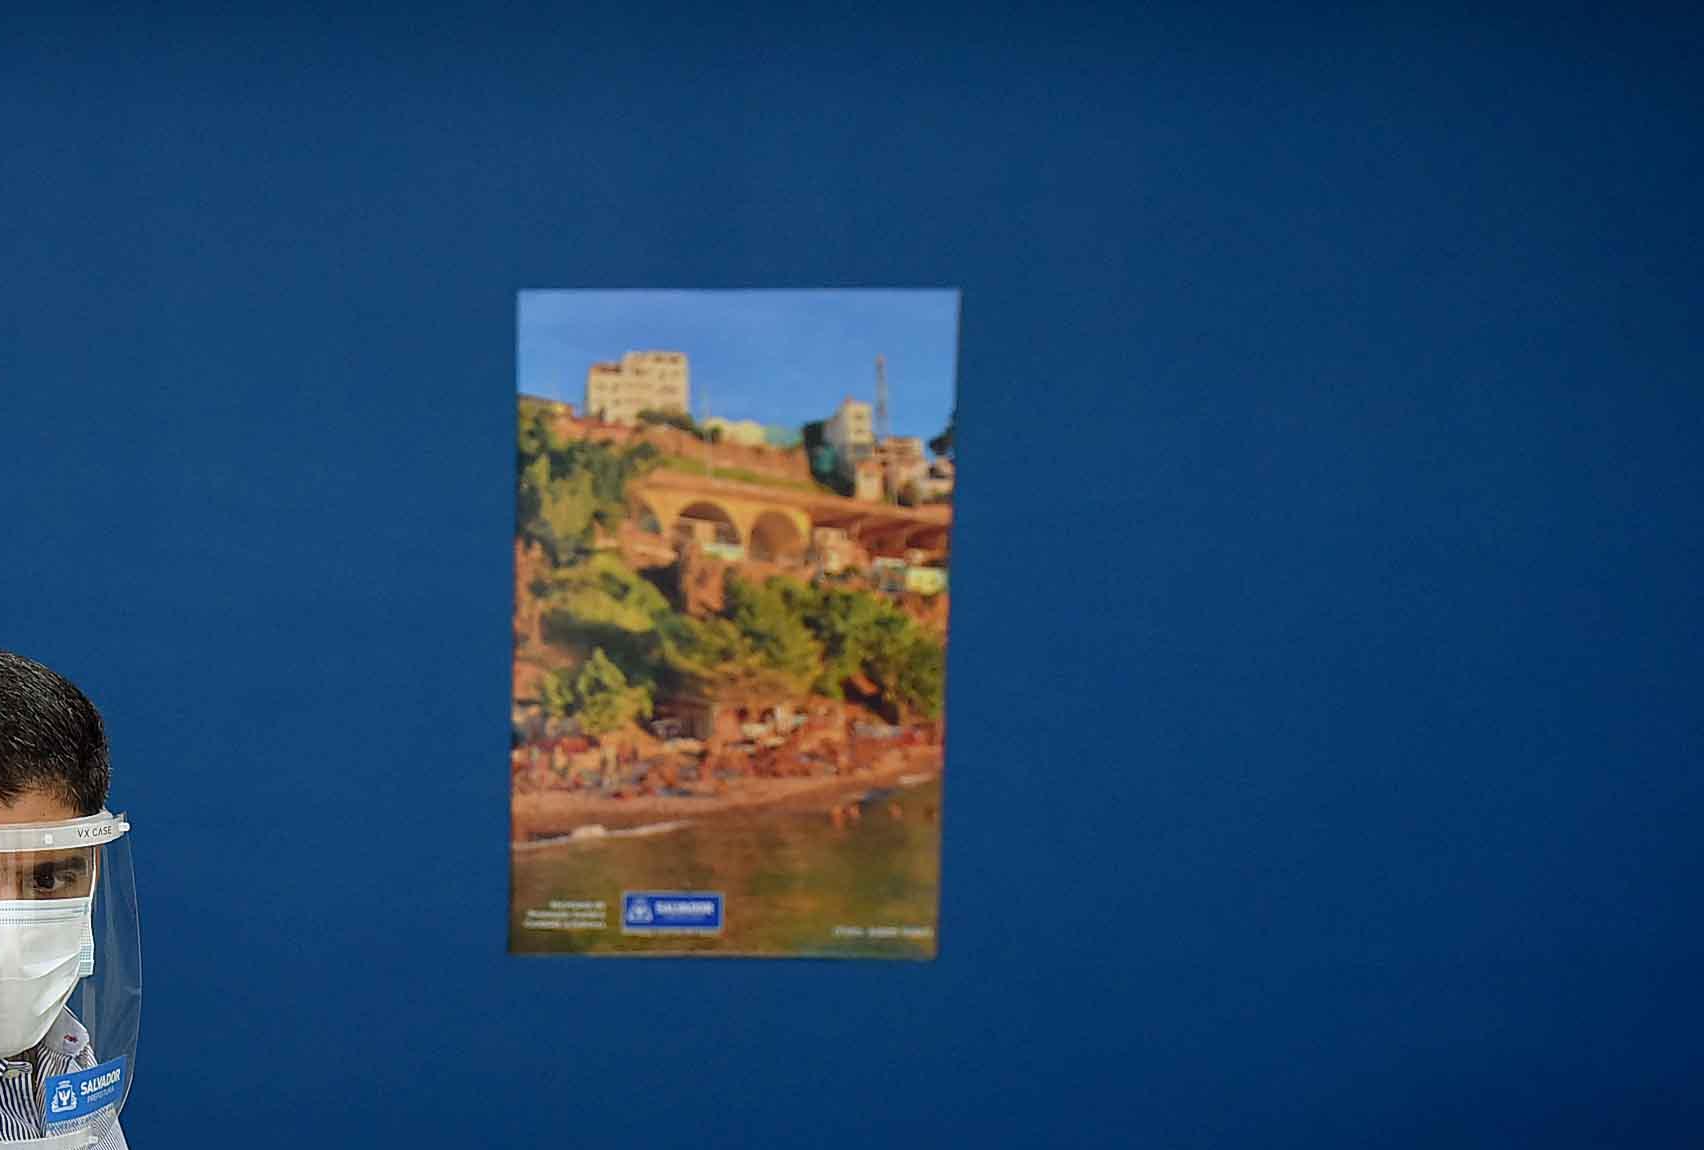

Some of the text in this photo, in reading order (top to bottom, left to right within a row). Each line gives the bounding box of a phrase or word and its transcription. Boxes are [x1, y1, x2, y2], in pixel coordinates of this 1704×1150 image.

[77, 825, 112, 838] VX CASE
[80, 1068, 121, 1096] SALVADOR
